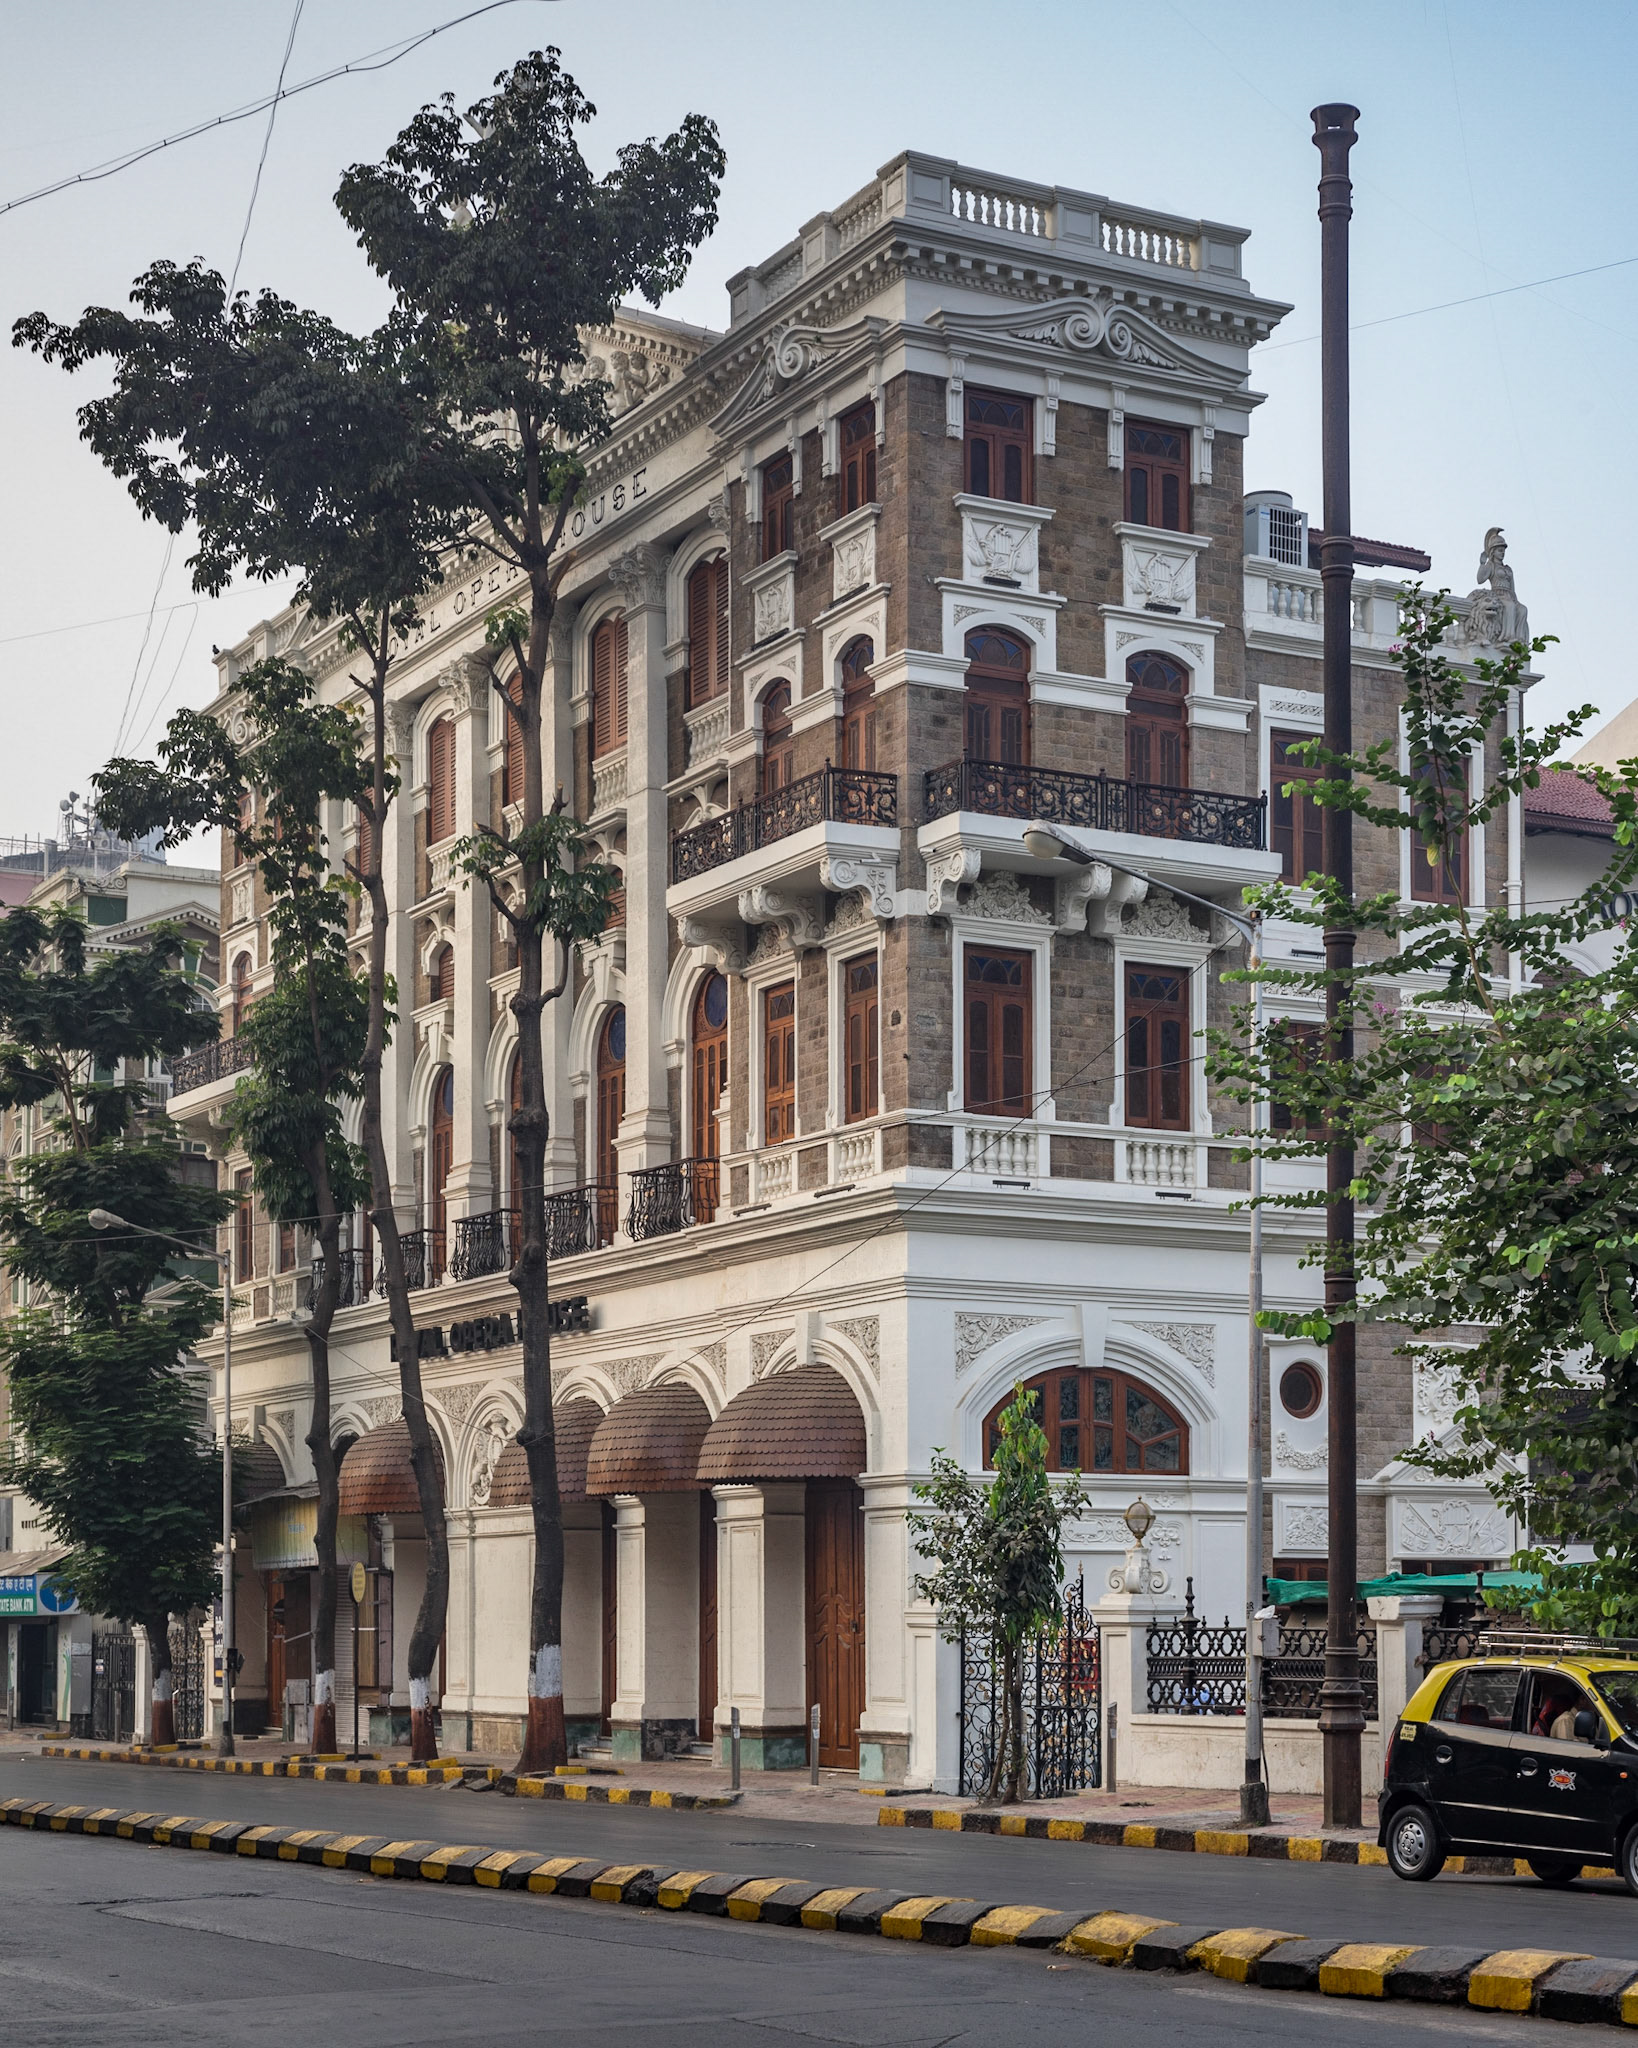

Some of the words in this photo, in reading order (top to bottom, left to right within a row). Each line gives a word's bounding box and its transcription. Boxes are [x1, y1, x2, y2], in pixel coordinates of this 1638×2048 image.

[453, 553, 521, 616] OPER
[450, 1313, 516, 1353] OPERA
[10, 1598, 23, 1612] BANK
[23, 1598, 34, 1612] ATM
